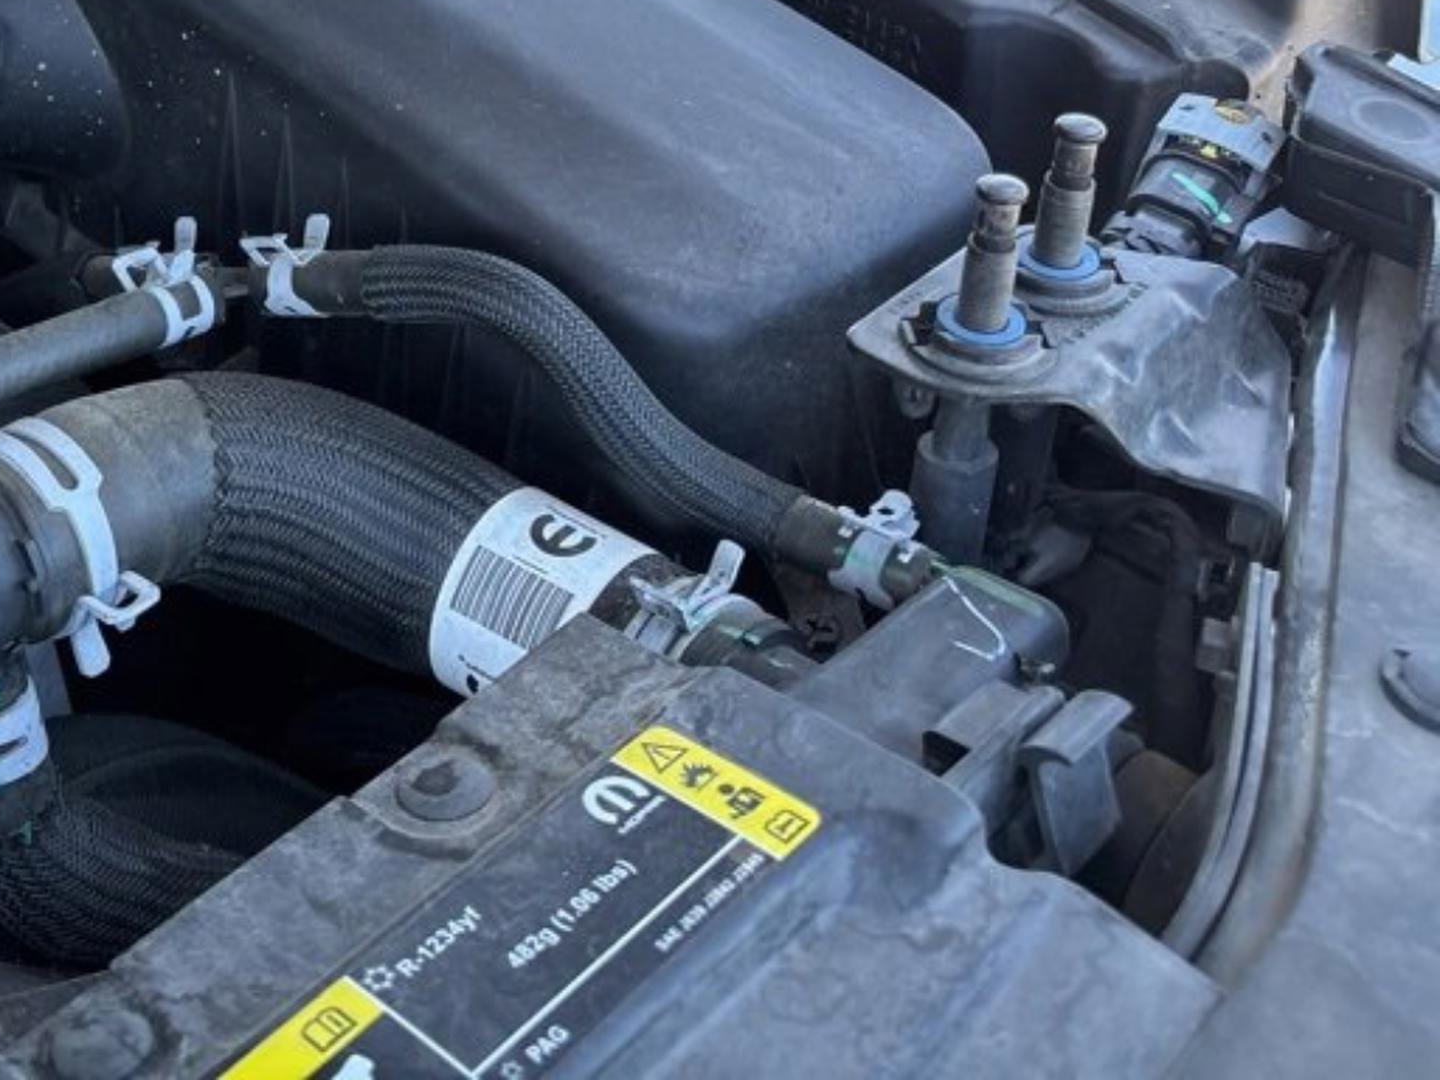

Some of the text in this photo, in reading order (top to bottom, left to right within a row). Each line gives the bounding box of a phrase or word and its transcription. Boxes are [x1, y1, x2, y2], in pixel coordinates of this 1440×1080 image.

[394, 904, 483, 979] R-1234yf
[507, 858, 638, 969] 482g (1.06 lbs)
[524, 1024, 570, 1065] PAG
